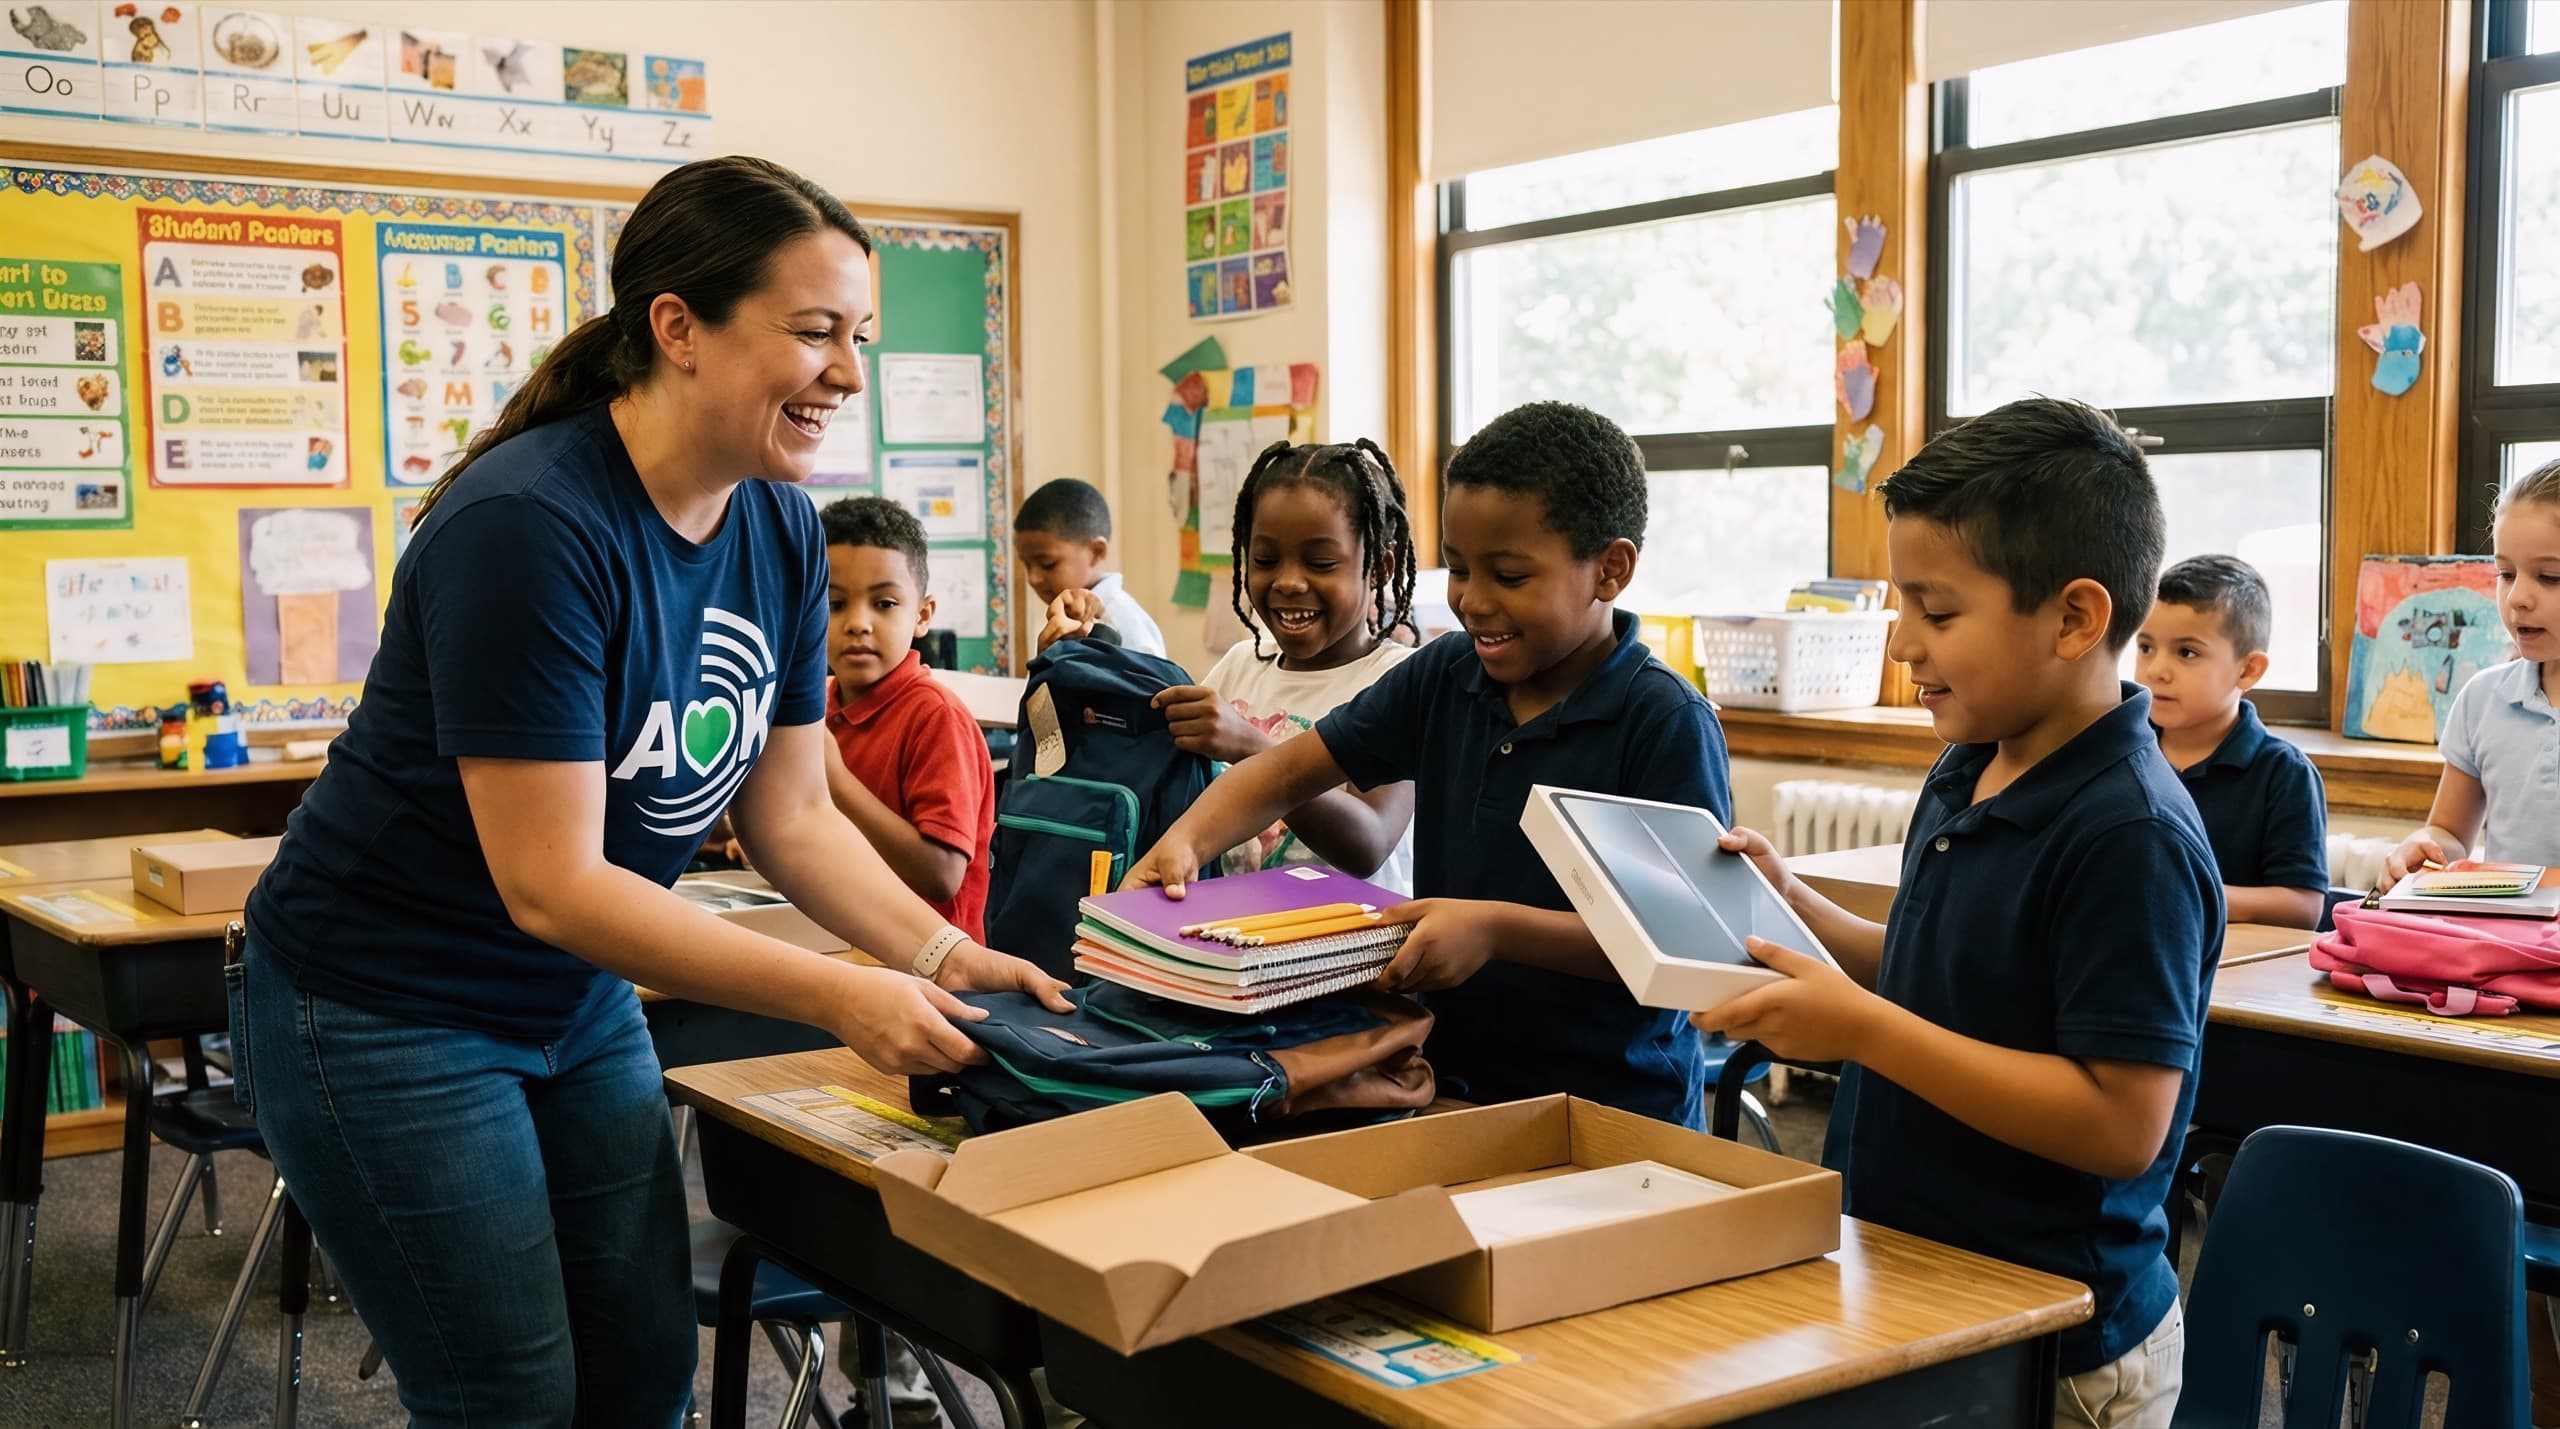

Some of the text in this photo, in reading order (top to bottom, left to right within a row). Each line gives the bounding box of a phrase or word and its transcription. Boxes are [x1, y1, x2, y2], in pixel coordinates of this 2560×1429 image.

[25, 65, 73, 96] Oo
[133, 74, 170, 116] Pp
[233, 84, 267, 112] Rr
[322, 93, 360, 121] Uu
[500, 107, 532, 135] Xx
[583, 114, 614, 152] Yy
[40, 264, 67, 286] to
[154, 257, 182, 287] A
[157, 302, 184, 333] B
[162, 394, 191, 424] D
[165, 439, 188, 469] E
